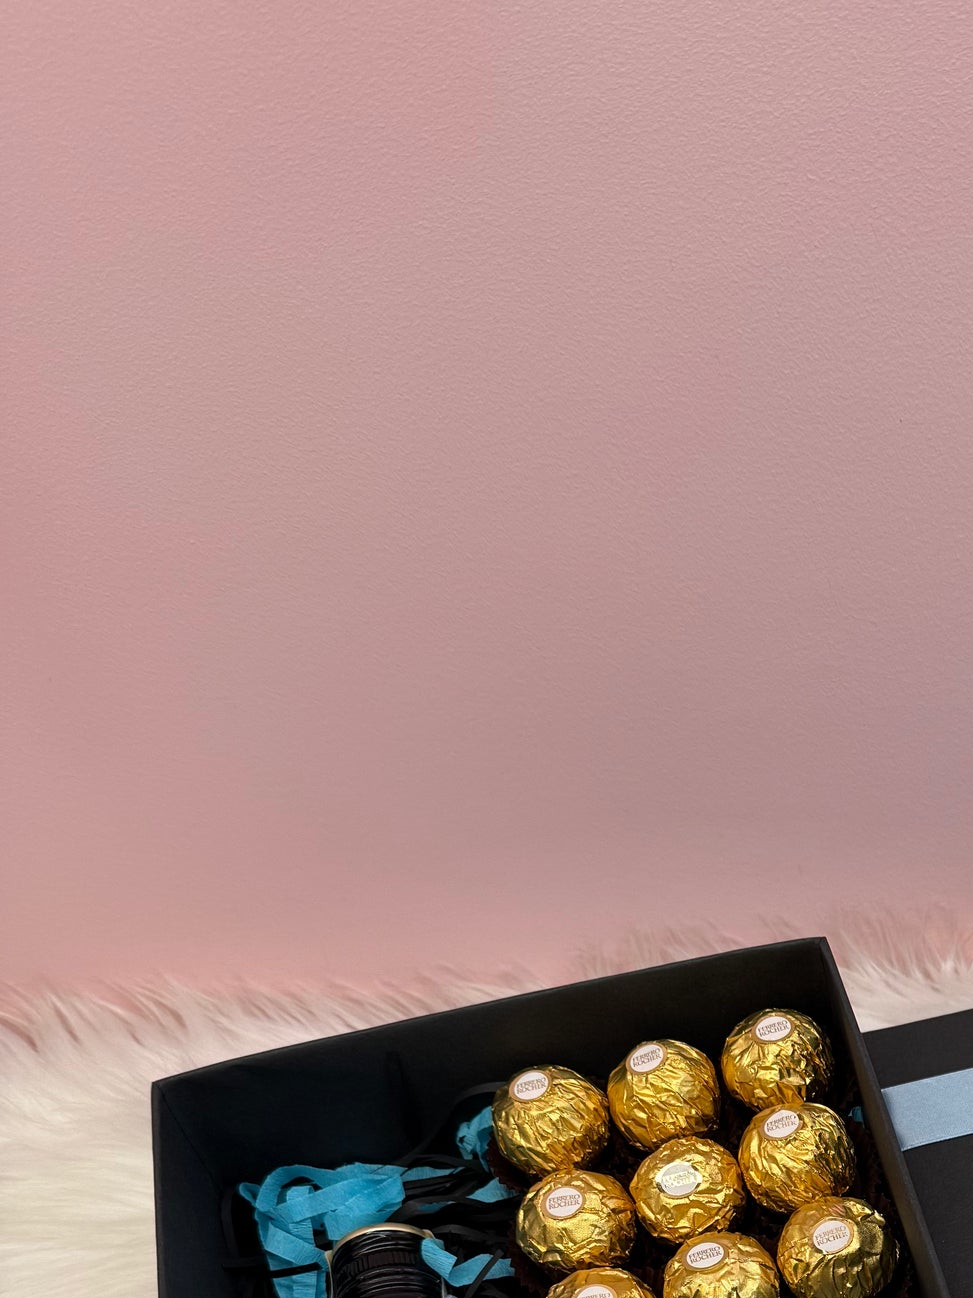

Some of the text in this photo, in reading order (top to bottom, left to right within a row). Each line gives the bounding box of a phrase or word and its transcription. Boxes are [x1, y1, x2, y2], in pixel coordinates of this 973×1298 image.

[758, 1020, 788, 1032] FERRERO
[759, 1025, 789, 1037] ROCHER
[632, 1048, 661, 1061] FERRERO
[633, 1054, 662, 1068] ROCHER
[516, 1083, 546, 1094] ROCHER
[766, 1120, 798, 1132] ROCHER
[549, 1193, 580, 1204] FERRERO
[549, 1199, 580, 1210] ROCHER
[814, 1225, 847, 1240] FERRERO
[816, 1231, 849, 1246] ROCHER
[688, 1246, 721, 1260] FERRERO
[690, 1251, 722, 1264] ROCHER
